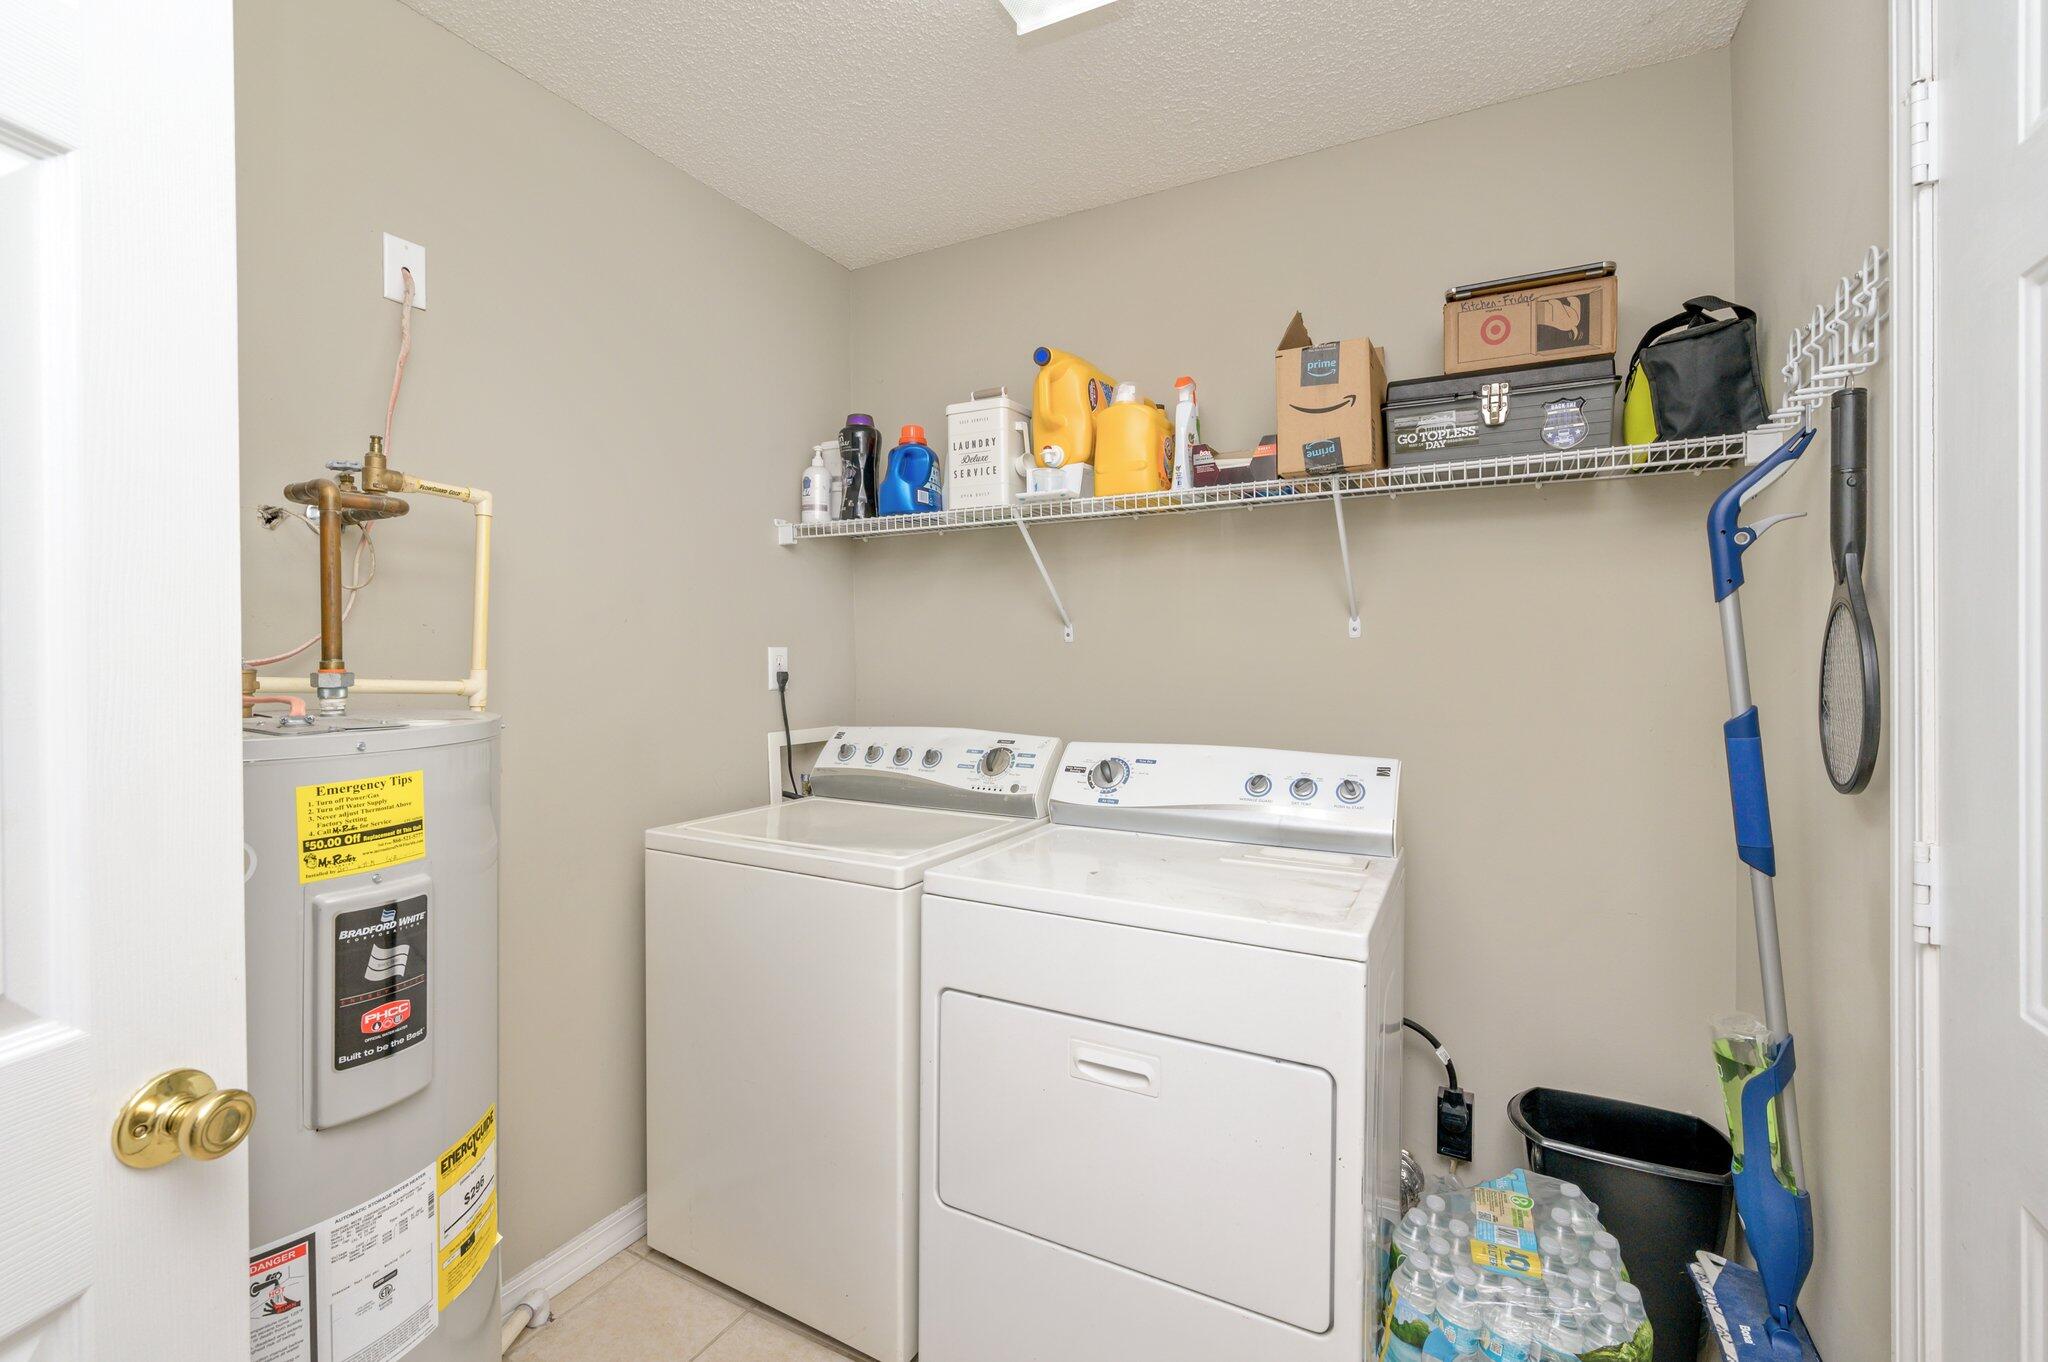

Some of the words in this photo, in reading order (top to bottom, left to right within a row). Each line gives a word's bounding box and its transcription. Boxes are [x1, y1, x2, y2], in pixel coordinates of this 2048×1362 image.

[1307, 359, 1337, 371] prime
[1397, 433, 1418, 445] GO
[1419, 426, 1476, 442] TOPLESS
[953, 437, 997, 451] LAUNDRY
[1306, 444, 1336, 458] prime
[1425, 439, 1447, 450] DAY
[961, 454, 989, 464] Deluxe
[953, 466, 997, 479] SERVICE
[316, 780, 387, 797] Emergency
[389, 775, 413, 787] Tips
[316, 799, 333, 807] Turn
[345, 801, 365, 809] Water
[367, 798, 388, 807] Supply
[316, 813, 336, 821] Never
[338, 810, 359, 819] adjust
[361, 804, 394, 814] Thermostat
[316, 820, 343, 828] Factory
[344, 816, 368, 825] Setting
[370, 819, 392, 827] Service
[304, 836, 342, 850] $50.00
[344, 834, 362, 845] Off
[332, 853, 357, 866] Rooter
[305, 870, 332, 879] Installed
[338, 920, 397, 940] BRADFORD
[398, 911, 427, 927] WHITE
[364, 1002, 409, 1024] PHCC
[338, 1051, 362, 1064] Built
[363, 1048, 375, 1057] to
[376, 1043, 389, 1053] be
[390, 1037, 405, 1048] the
[334, 1206, 367, 1224] AUTOMATIC
[367, 1192, 392, 1209] STORAGE
[392, 1182, 409, 1195] WATER
[409, 1172, 426, 1186] HEATER
[250, 1250, 296, 1274] DANGER
[268, 1286, 286, 1298] HOT
[1739, 1324, 1754, 1345] Bona
